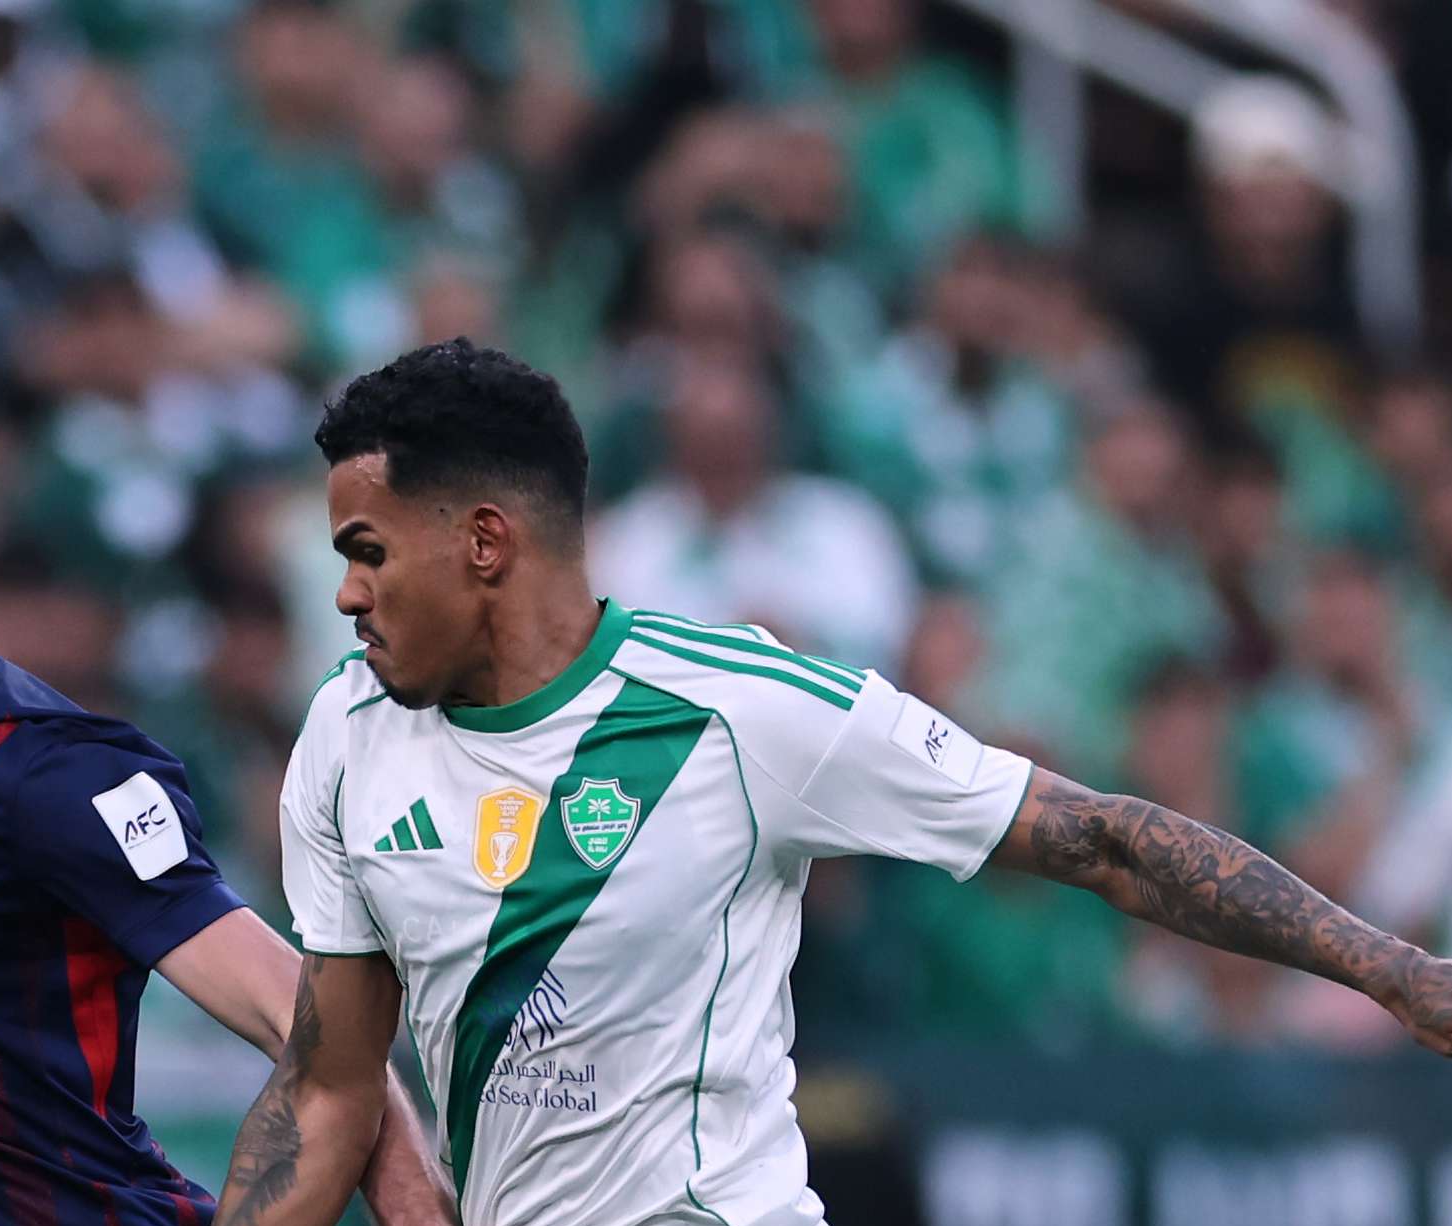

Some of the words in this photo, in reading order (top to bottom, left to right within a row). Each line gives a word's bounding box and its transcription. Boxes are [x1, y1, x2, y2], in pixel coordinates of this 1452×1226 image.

[125, 803, 167, 844] AFC
[499, 1084, 531, 1107] Sea
[534, 1087, 596, 1112] Global
